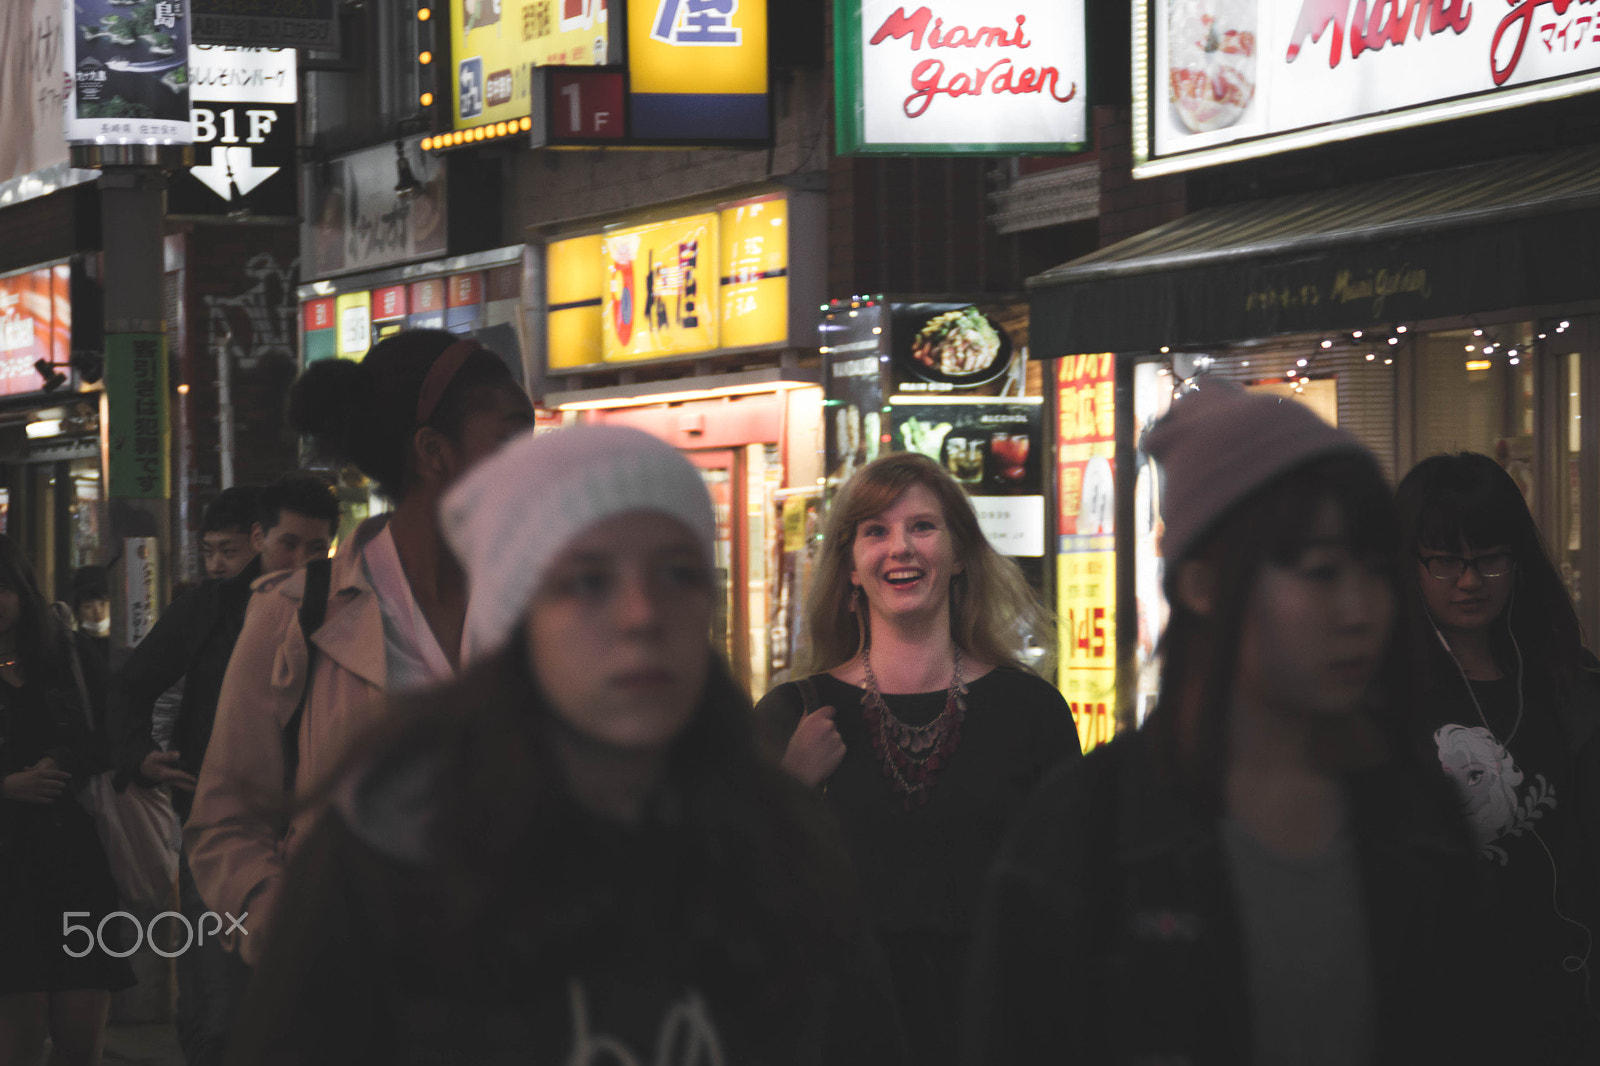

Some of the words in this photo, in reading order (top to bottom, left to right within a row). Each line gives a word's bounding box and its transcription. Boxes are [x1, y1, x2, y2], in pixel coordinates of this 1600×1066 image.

[869, 6, 1031, 51] Miami
[190, 108, 278, 143] B1F
[1069, 607, 1105, 658] 145
